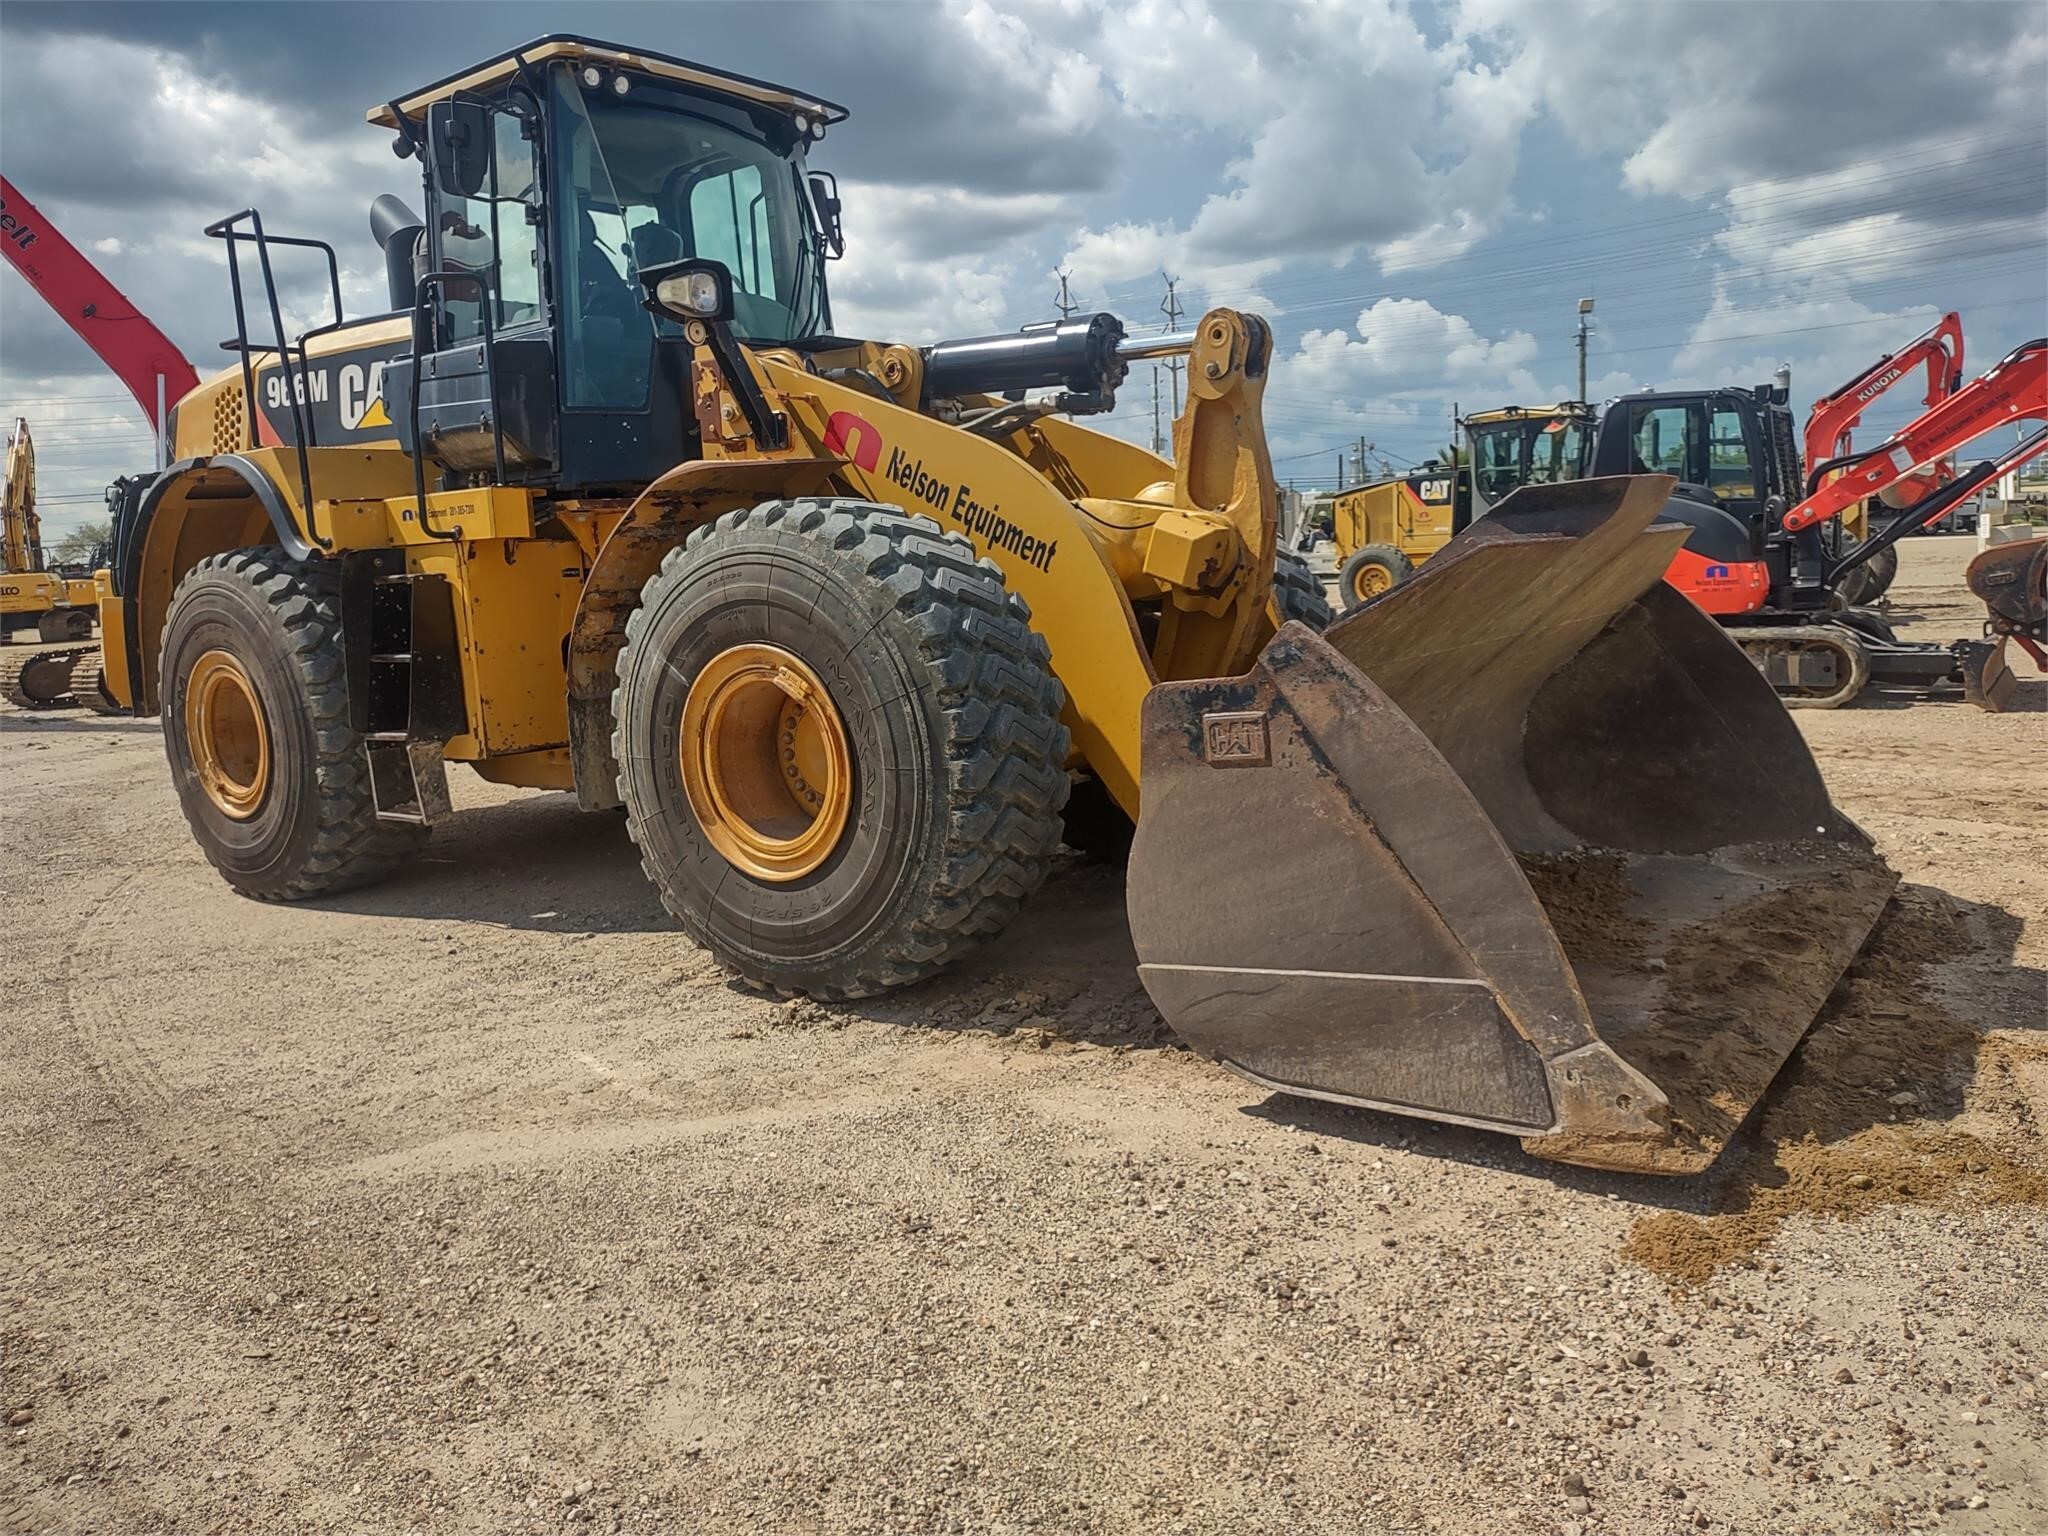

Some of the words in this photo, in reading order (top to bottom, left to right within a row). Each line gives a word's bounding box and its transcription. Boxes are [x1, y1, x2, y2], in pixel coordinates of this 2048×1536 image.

[0, 199, 38, 250] elt
[267, 369, 329, 409] 966M
[339, 360, 385, 431] CA
[1857, 369, 1902, 402] KUBOTA
[1420, 480, 1451, 500] CAT
[885, 446, 951, 511] Nelson
[951, 484, 1058, 573] Equipment
[0, 586, 20, 596] LCO
[1208, 720, 1263, 755] CAT
